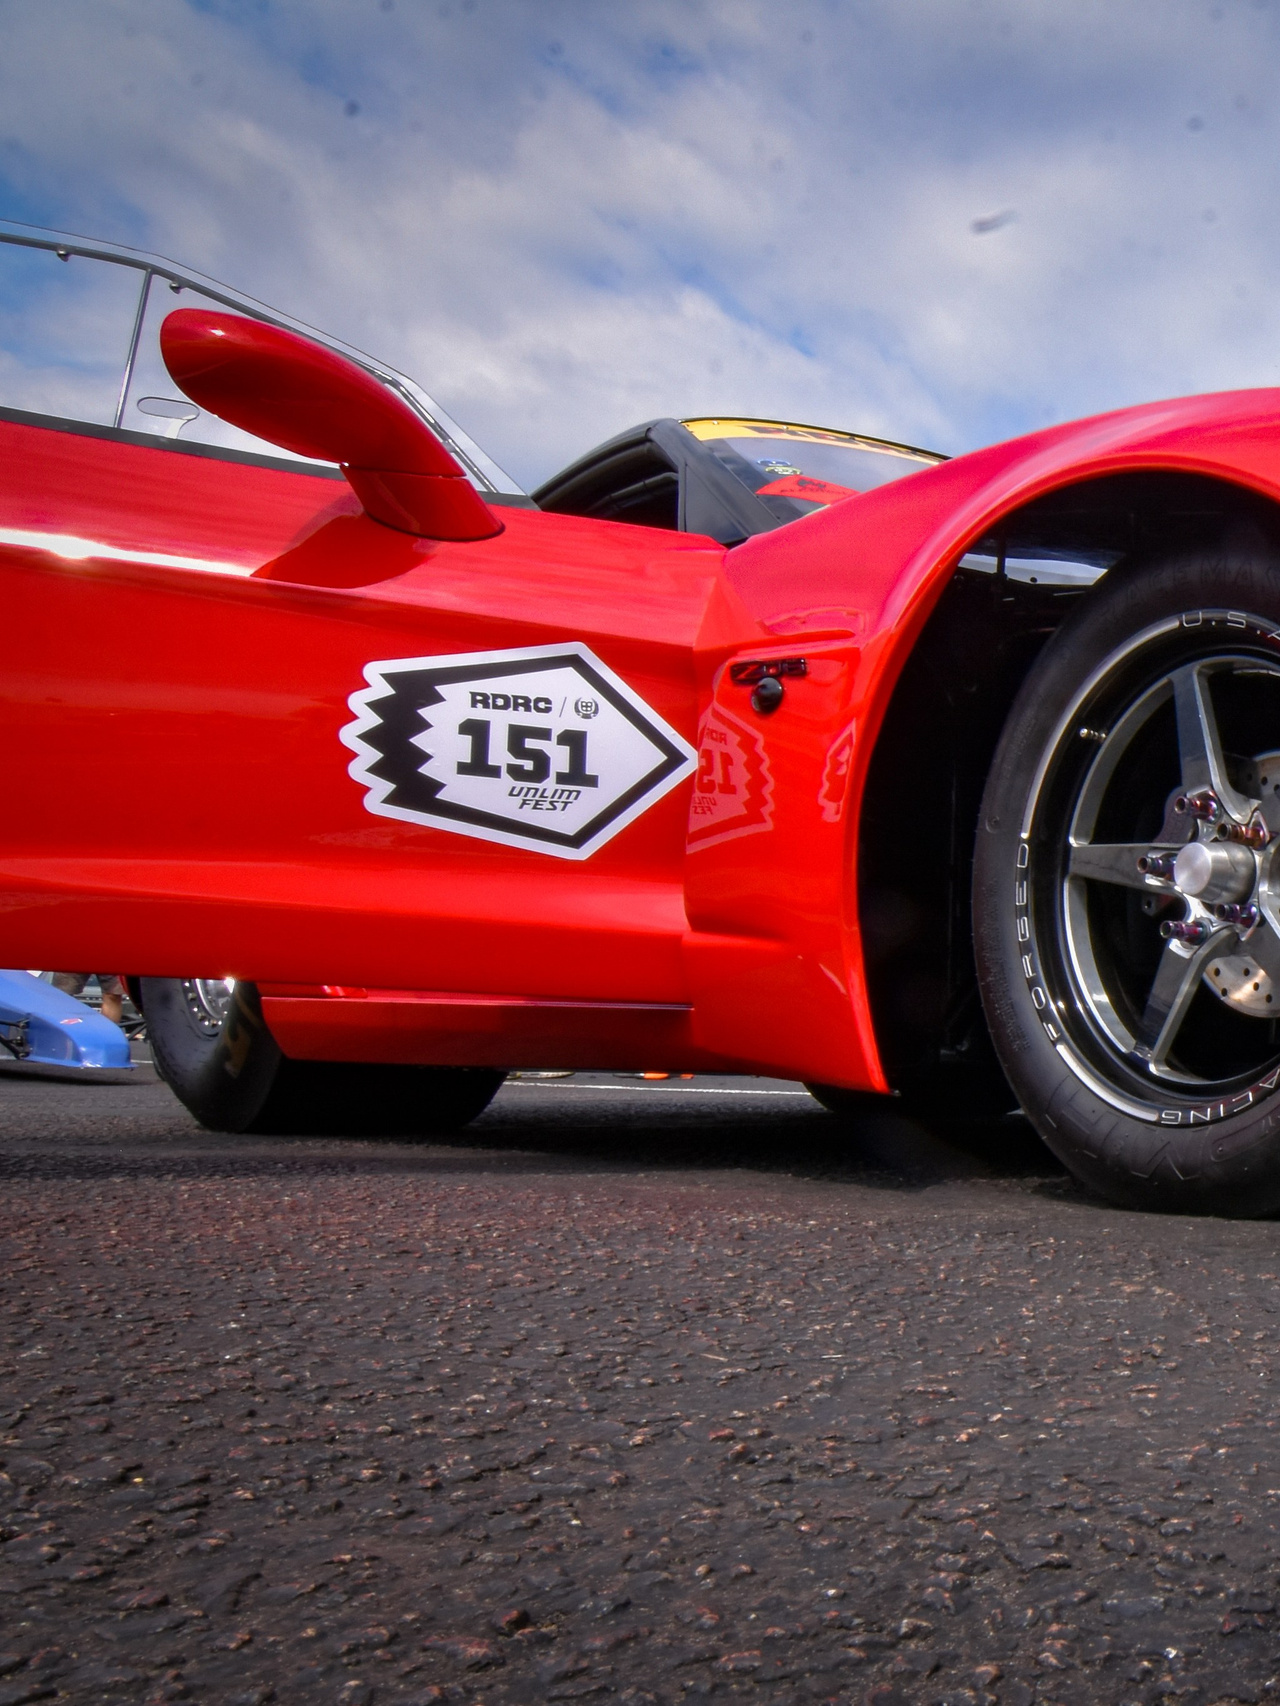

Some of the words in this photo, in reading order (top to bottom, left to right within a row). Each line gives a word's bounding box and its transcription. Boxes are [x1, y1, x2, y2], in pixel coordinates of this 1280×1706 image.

[469, 691, 552, 714] RDRC
[456, 718, 599, 788] 151
[508, 786, 582, 801] UNLIM
[518, 798, 573, 812] FEST
[1015, 843, 1061, 1041] FORGED
